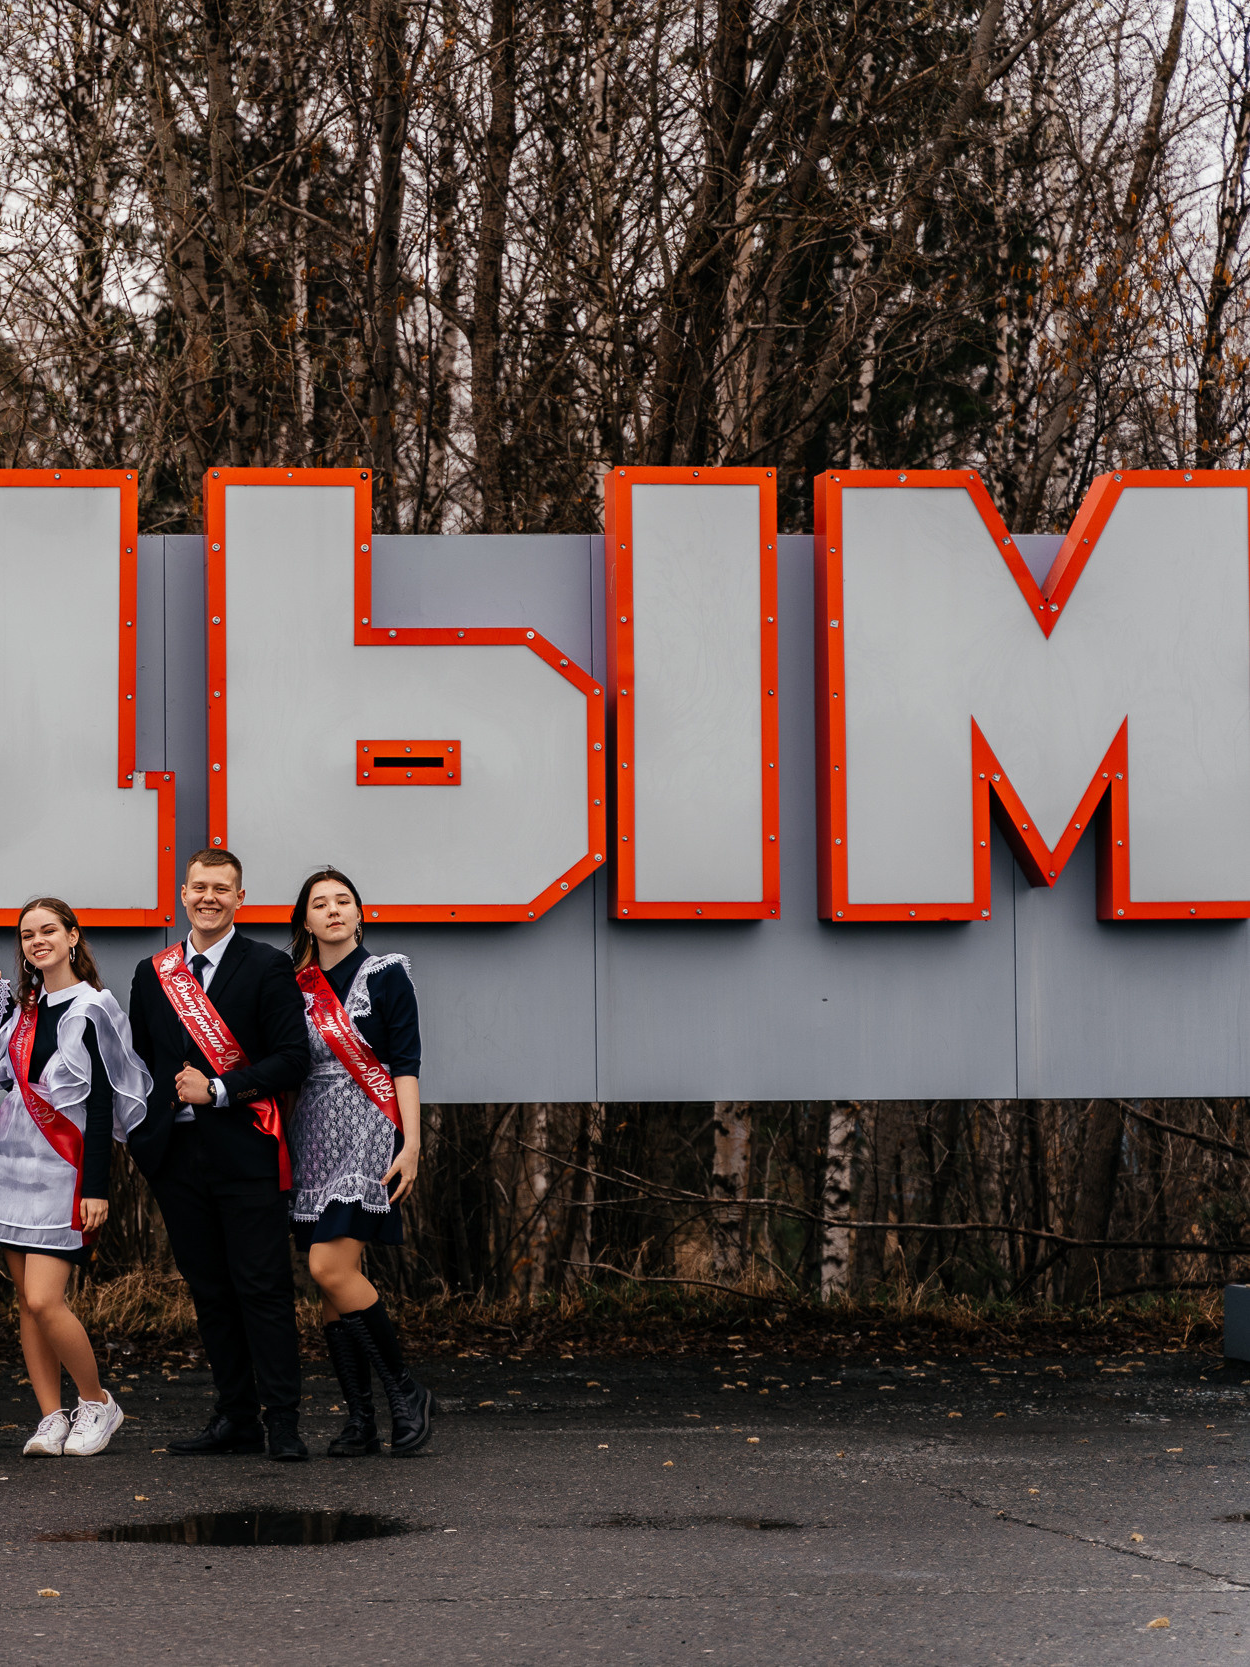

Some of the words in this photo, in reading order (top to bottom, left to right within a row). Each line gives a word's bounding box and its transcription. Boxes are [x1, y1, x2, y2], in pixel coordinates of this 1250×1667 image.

[171, 972, 225, 1053] Выпускник
[314, 989, 367, 1073] Выпускница
[361, 1066, 396, 1102] 2022
[26, 1094, 55, 1129] 2022
